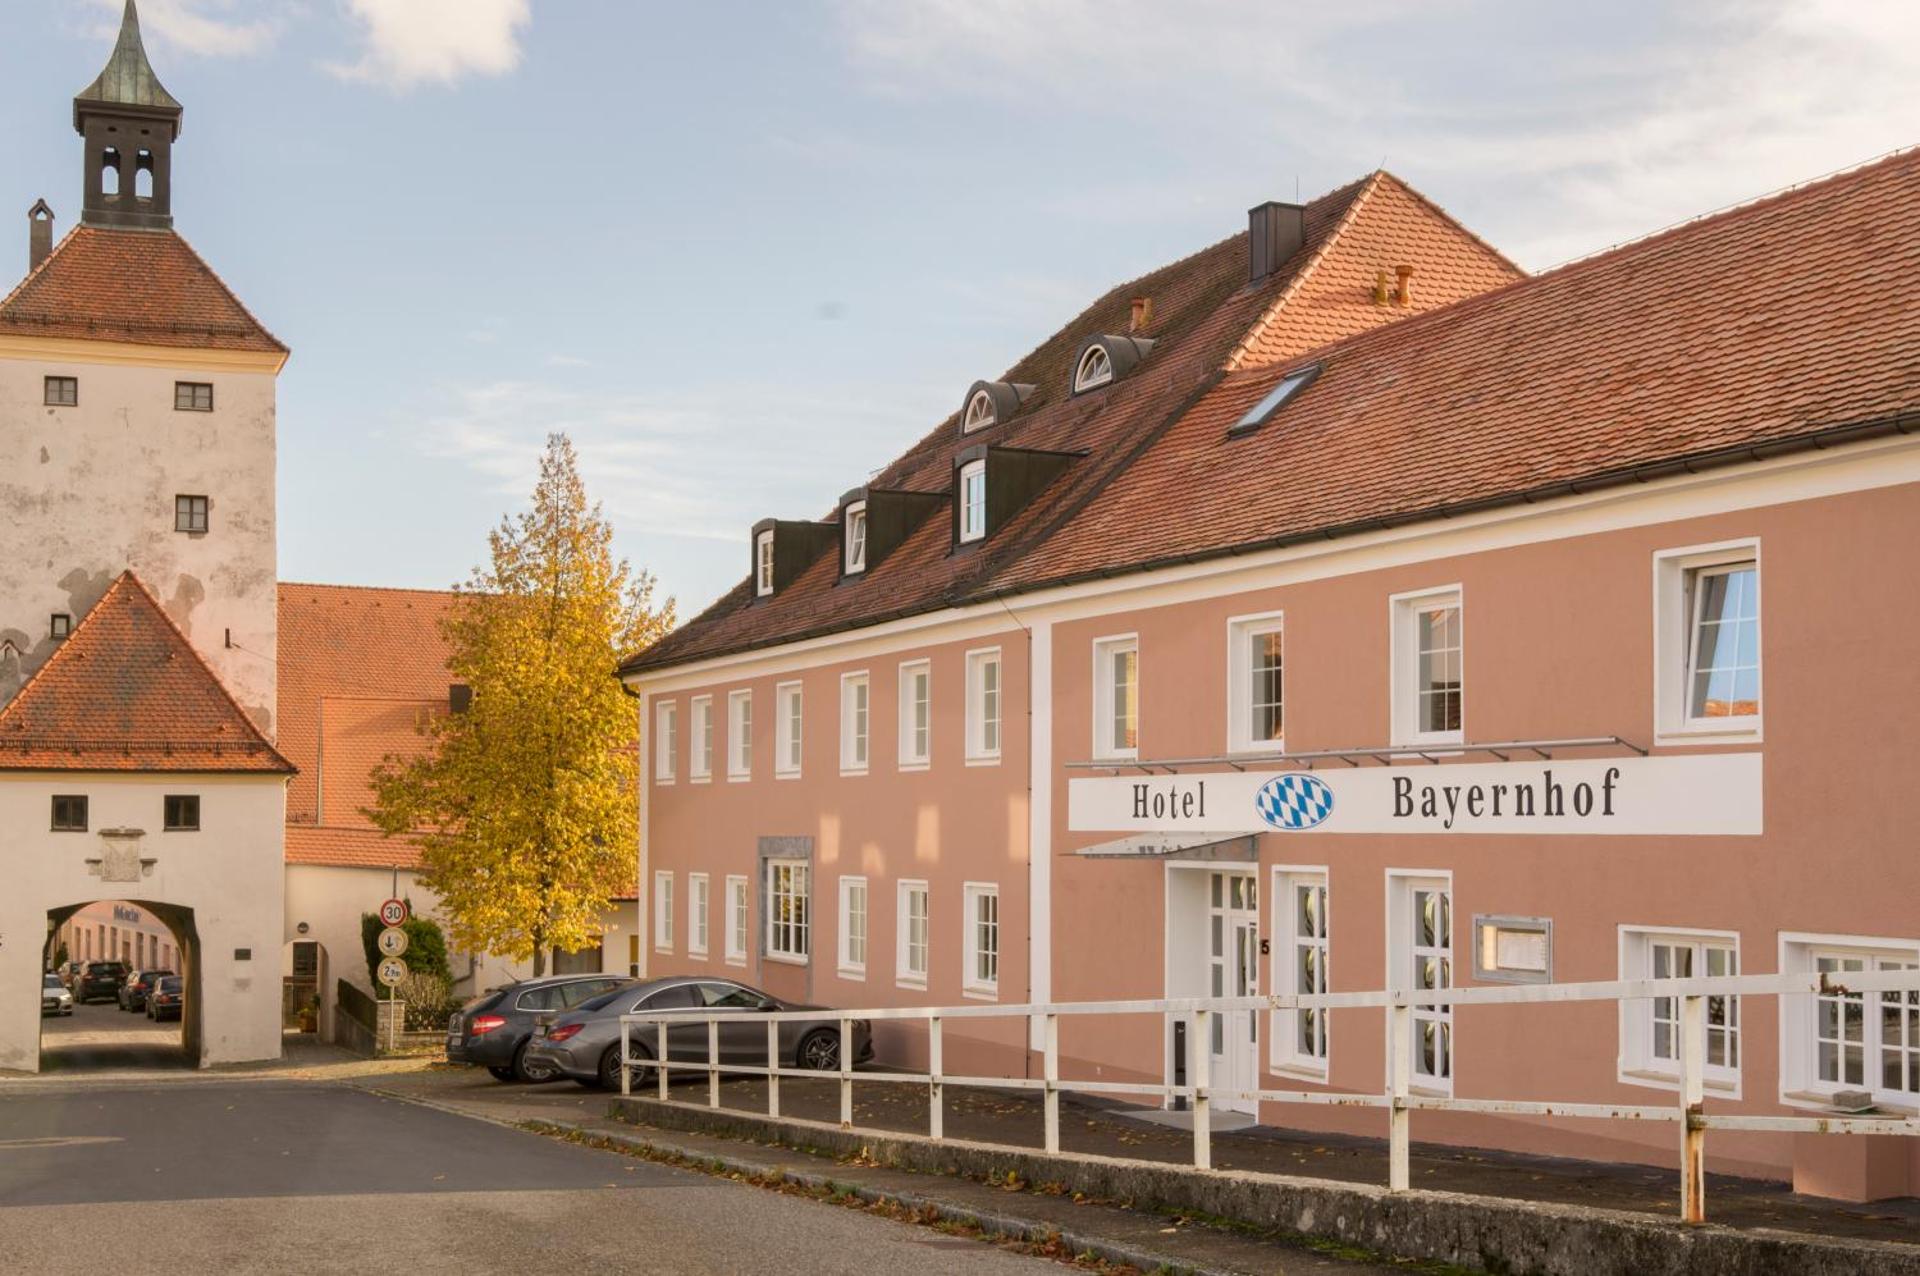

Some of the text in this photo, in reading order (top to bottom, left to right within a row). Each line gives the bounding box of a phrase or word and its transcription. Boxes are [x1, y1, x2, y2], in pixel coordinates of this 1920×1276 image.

[1132, 767, 1620, 829] Hotel Bayernhof
[386, 907, 402, 920] 30
